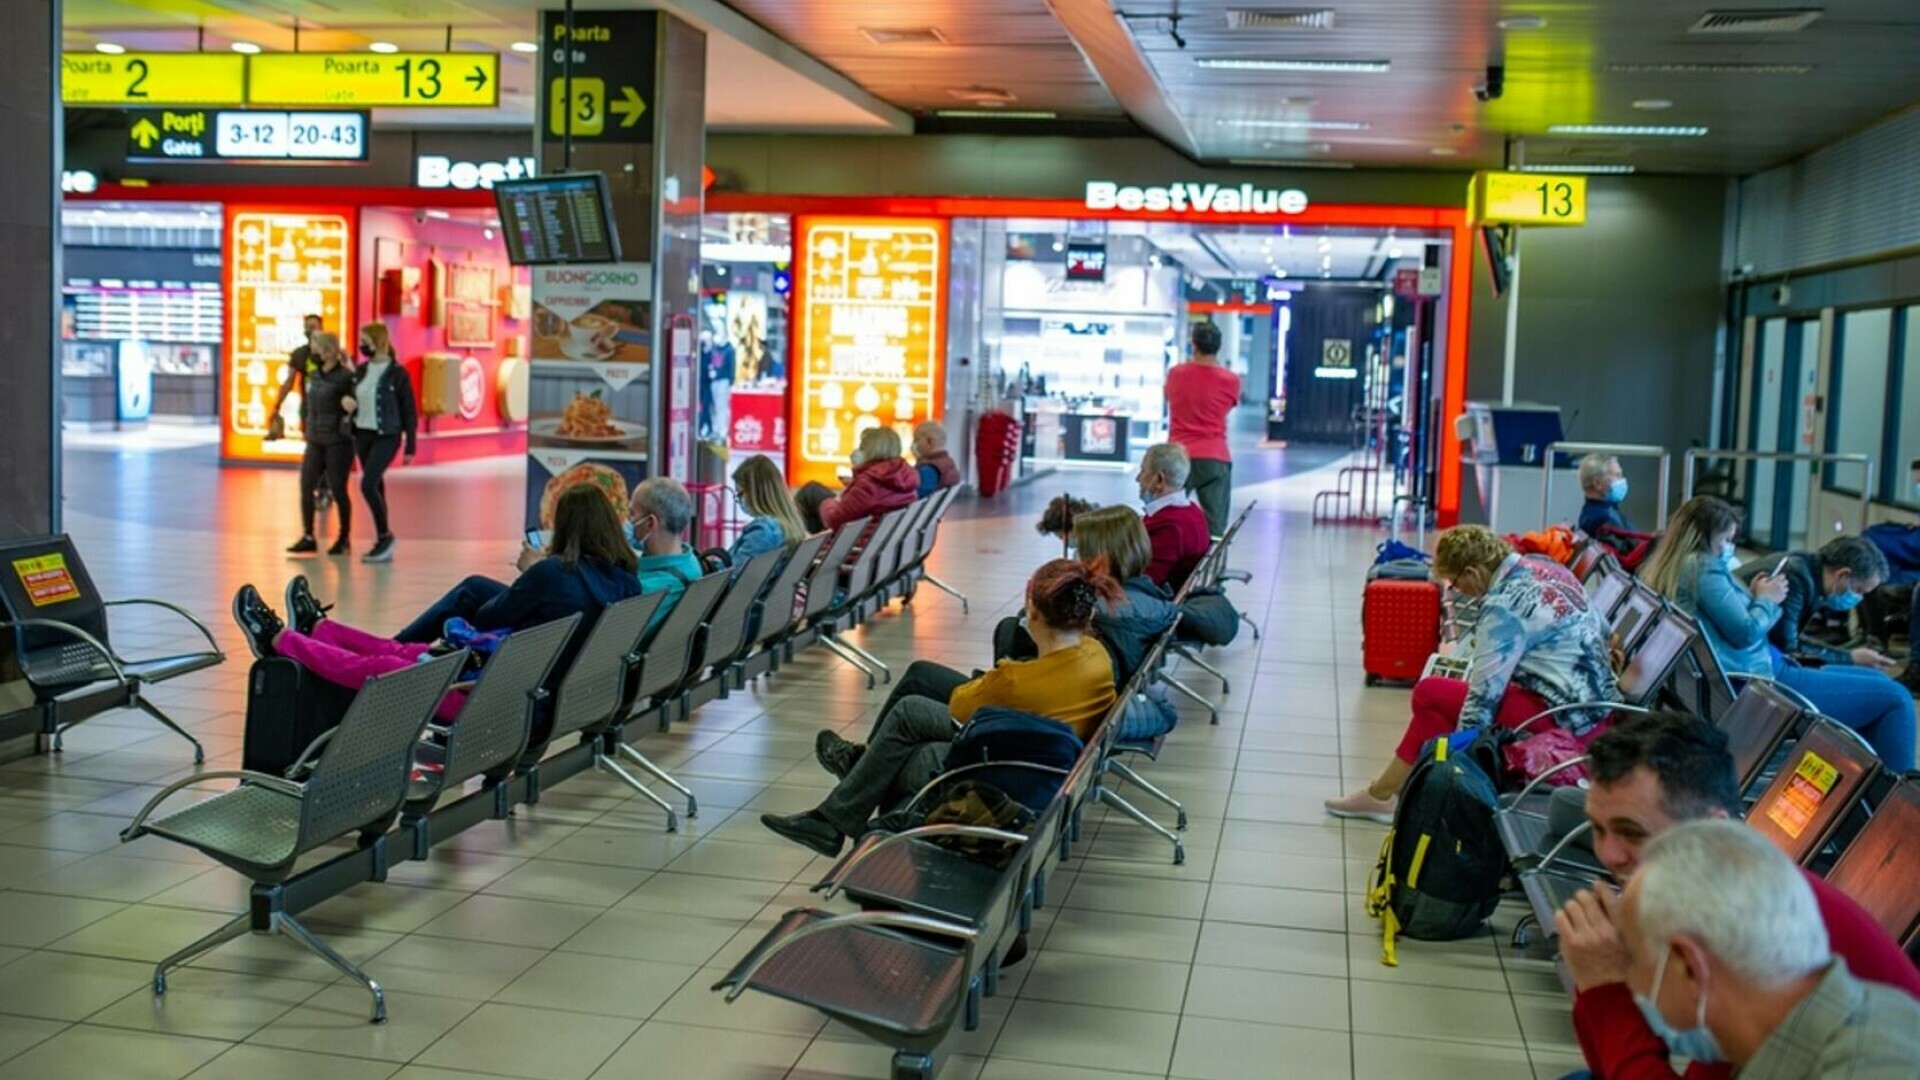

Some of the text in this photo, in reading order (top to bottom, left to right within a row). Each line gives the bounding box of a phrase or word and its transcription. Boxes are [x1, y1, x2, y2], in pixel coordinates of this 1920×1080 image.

[554, 25, 611, 41] Parta
[553, 48, 586, 63] Gte
[126, 59, 148, 97] 2
[324, 58, 442, 99] Poarta 13
[230, 124, 357, 145] 3-12 20-43
[163, 138, 203, 156] Gates
[1086, 181, 1308, 214] BestValue
[1537, 182, 1572, 216] 13
[545, 270, 638, 285] BUONGIORNO
